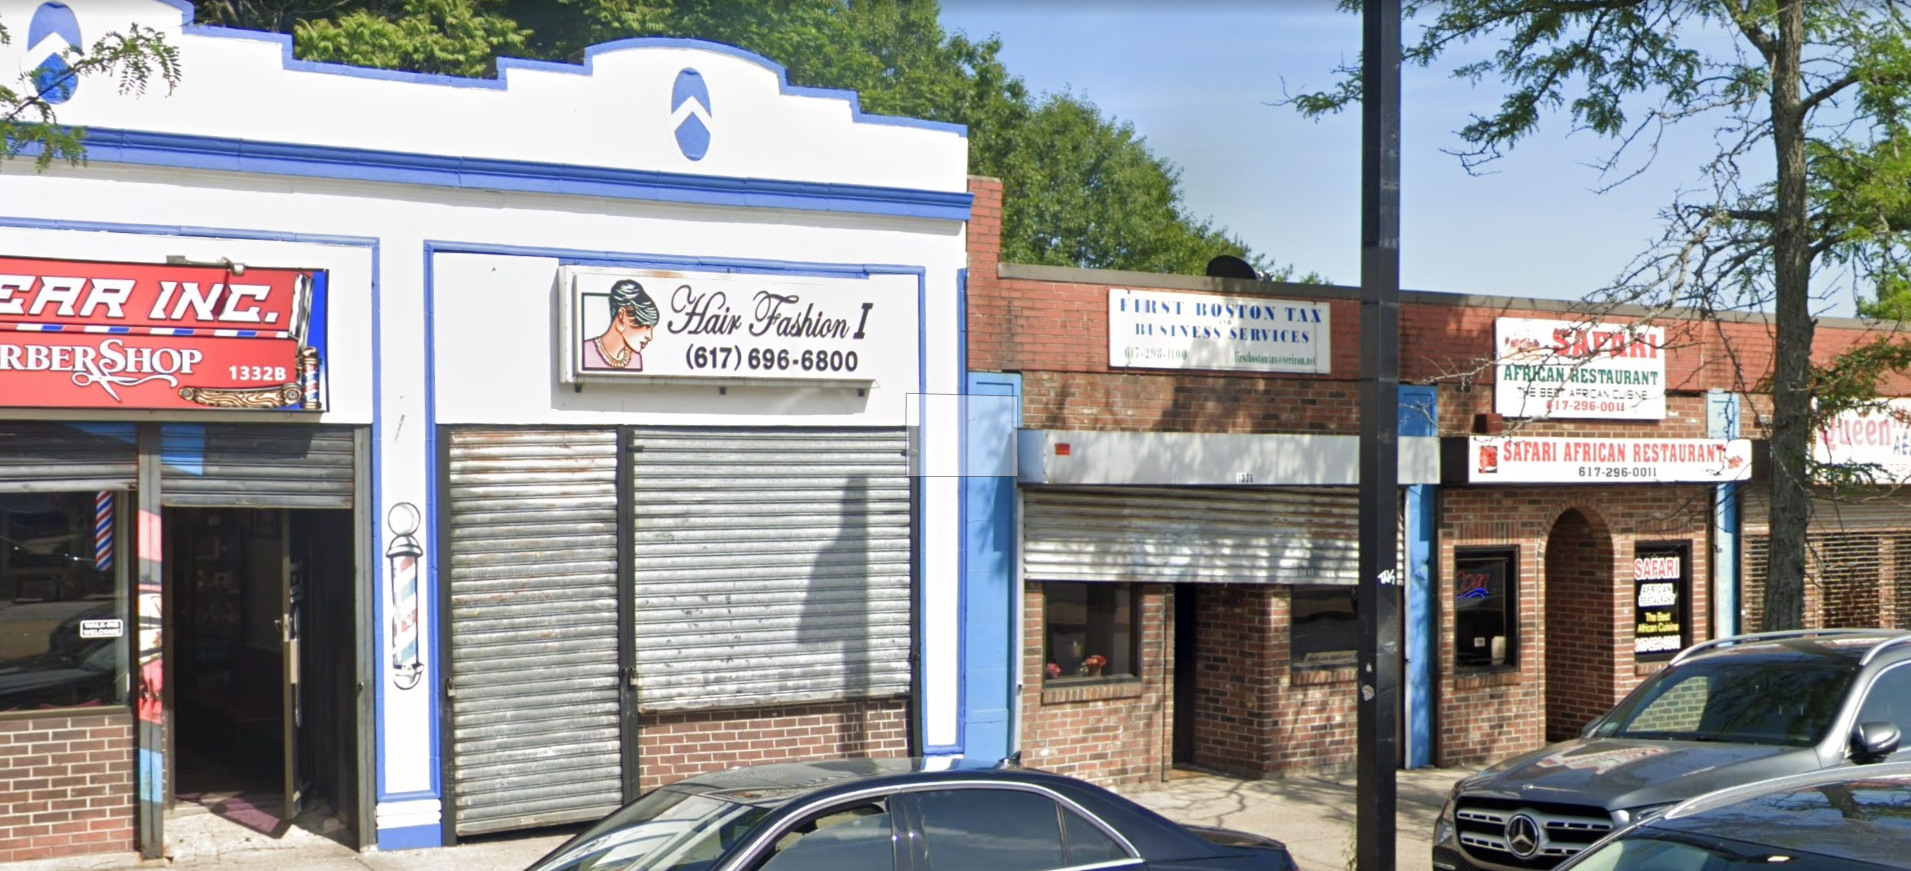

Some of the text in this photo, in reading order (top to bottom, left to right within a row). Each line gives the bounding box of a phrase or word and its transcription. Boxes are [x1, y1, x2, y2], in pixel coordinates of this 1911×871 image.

[148, 281, 279, 323] INC.
[667, 284, 742, 335] Hair
[749, 290, 850, 339] Fashion
[1120, 298, 1322, 323] FIRST BOSTON TAX
[1135, 323, 1310, 344] BUSINESS SERVICES
[1553, 329, 1657, 359] SAFARI
[686, 344, 859, 373] (617) 696-6800
[229, 365, 286, 381] 1332B
[1503, 364, 1659, 385] AFRICAN RESTAURANT
[1517, 387, 1536, 398] TE
[1540, 388, 1564, 398] BES
[1503, 441, 1724, 463] SAFARI AFRICAN RESTAURANT
[1578, 466, 1657, 478] 617-296-0011
[1634, 557, 1680, 580] SAFARI
[1645, 611, 1671, 622] The Best
[1637, 622, 1680, 633] African Cuisine
